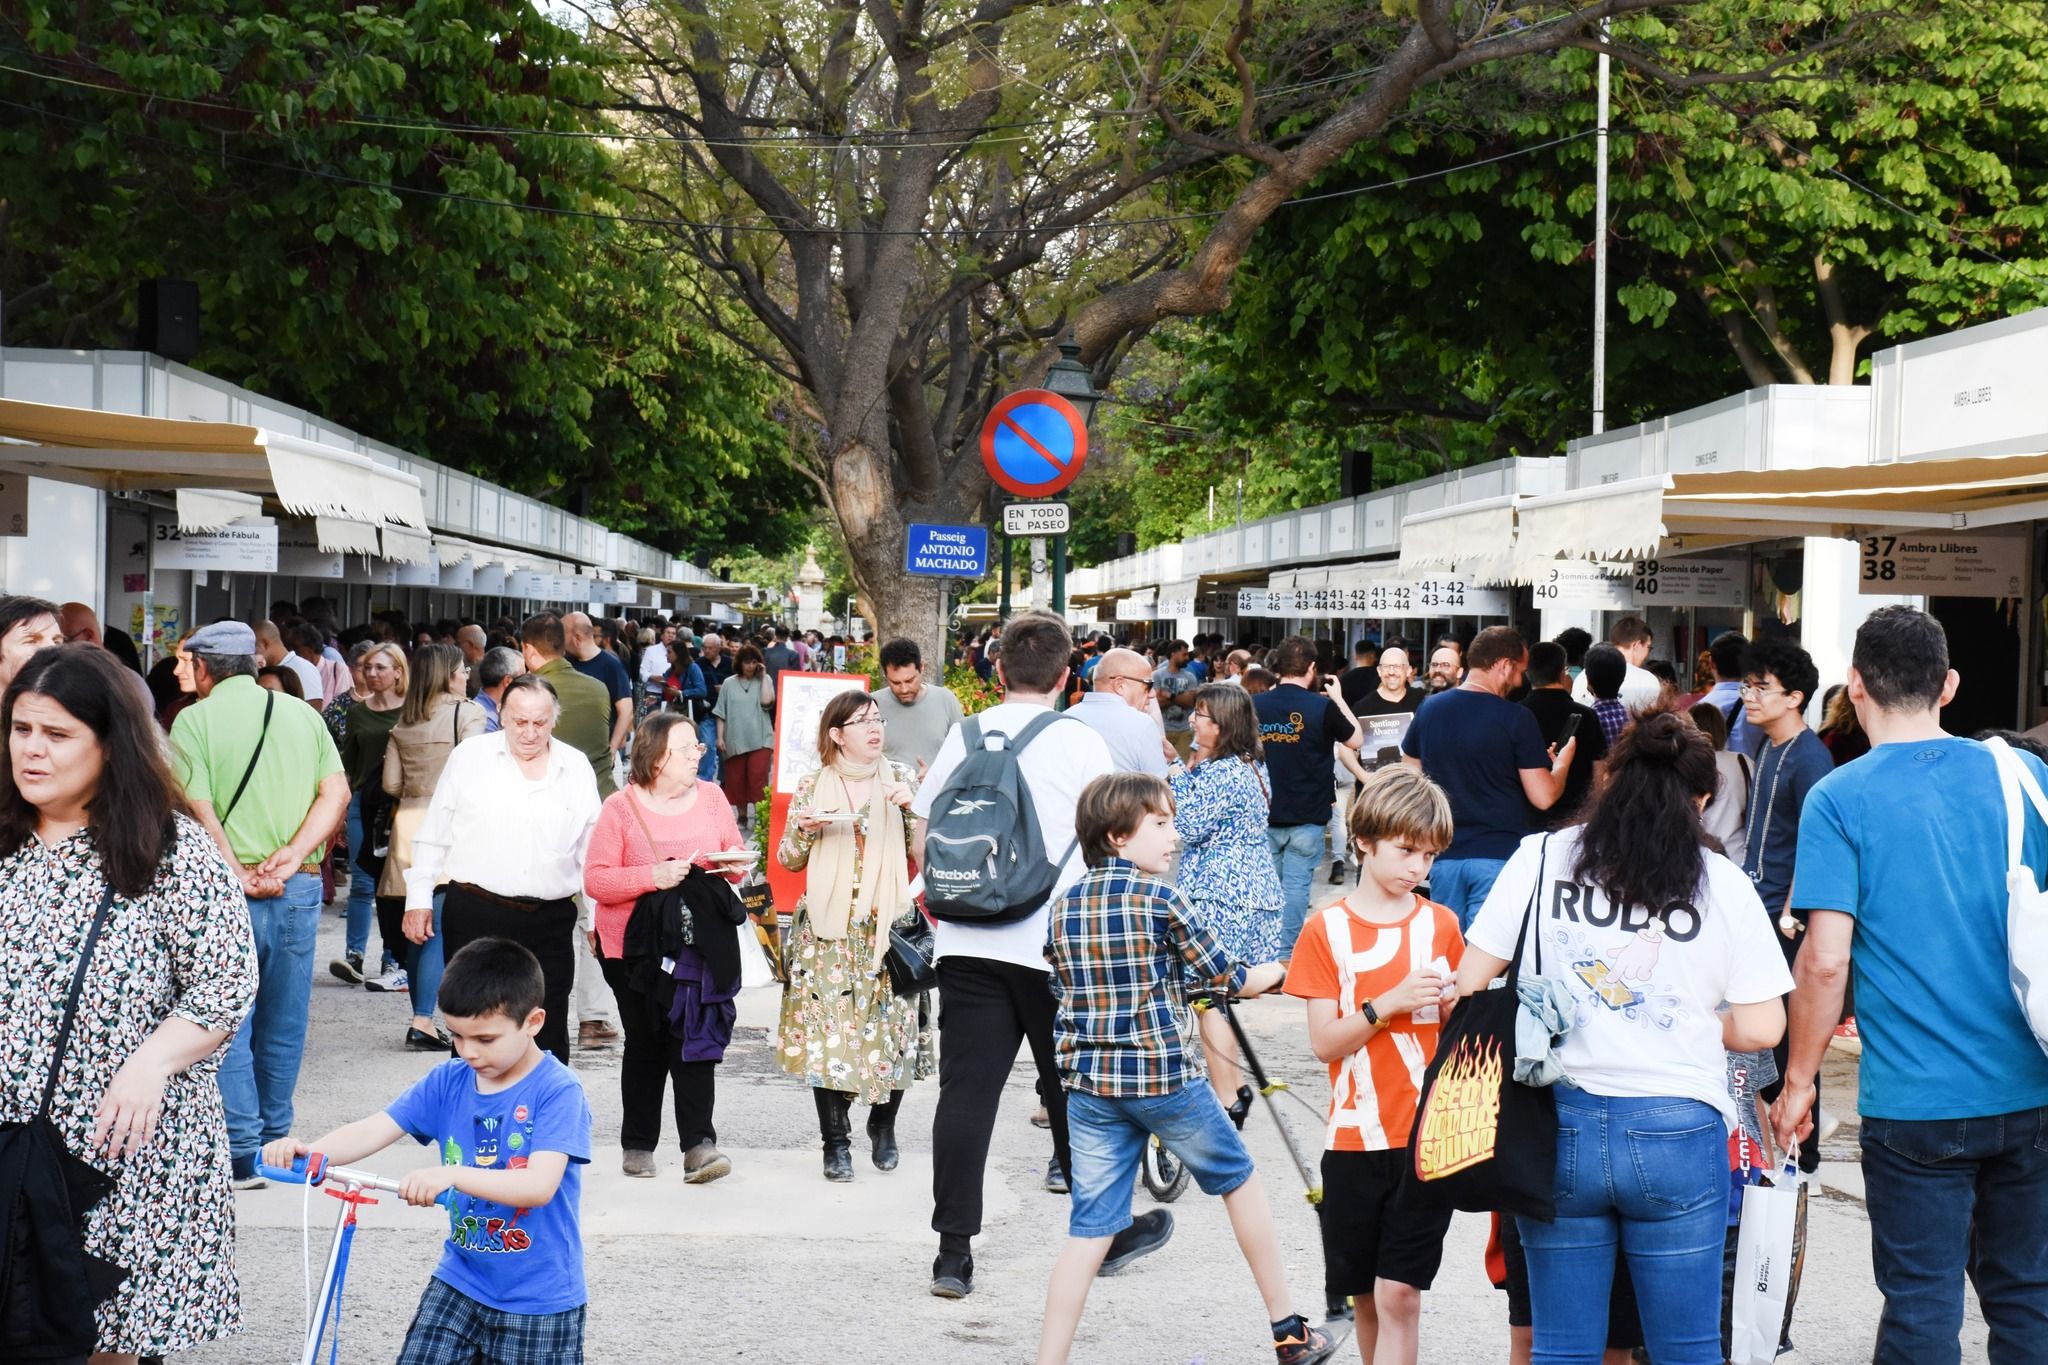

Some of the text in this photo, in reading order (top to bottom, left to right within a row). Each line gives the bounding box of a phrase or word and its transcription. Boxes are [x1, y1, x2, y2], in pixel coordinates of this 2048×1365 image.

[1009, 507, 1064, 519] EN TODO
[1008, 520, 1066, 531] EL PASEO
[156, 524, 182, 541] 32
[219, 530, 230, 539] de
[232, 530, 260, 540] Fábula
[929, 530, 967, 544] Passeig
[919, 544, 976, 557] ANTONIO
[1864, 536, 1978, 557] 37 Ambra Llibres
[915, 557, 978, 571] MACHADO
[1635, 560, 1724, 576] 39 Somnis de Paper
[1863, 559, 1896, 581] 38
[1561, 573, 1588, 581] Somnis
[1589, 573, 1599, 581] de
[1421, 581, 1465, 593] 41-42
[1536, 585, 1559, 599] 40
[1635, 578, 1659, 594] 40
[1239, 593, 1252, 601] 45
[1267, 593, 1281, 601] 45
[1295, 591, 1328, 600] 41-42
[1329, 590, 1366, 600] 41-42
[1371, 587, 1410, 598] 41-42
[1295, 601, 1328, 611] 43-44
[1329, 601, 1366, 611] 43-44
[1371, 599, 1410, 610] 43-44
[1421, 594, 1465, 606] 43-44
[1239, 602, 1252, 611] 46
[1267, 602, 1281, 611] 46
[1369, 718, 1400, 729] Santiago
[1551, 879, 1702, 943] RUDO
[465, 1227, 531, 1252] MASKS
